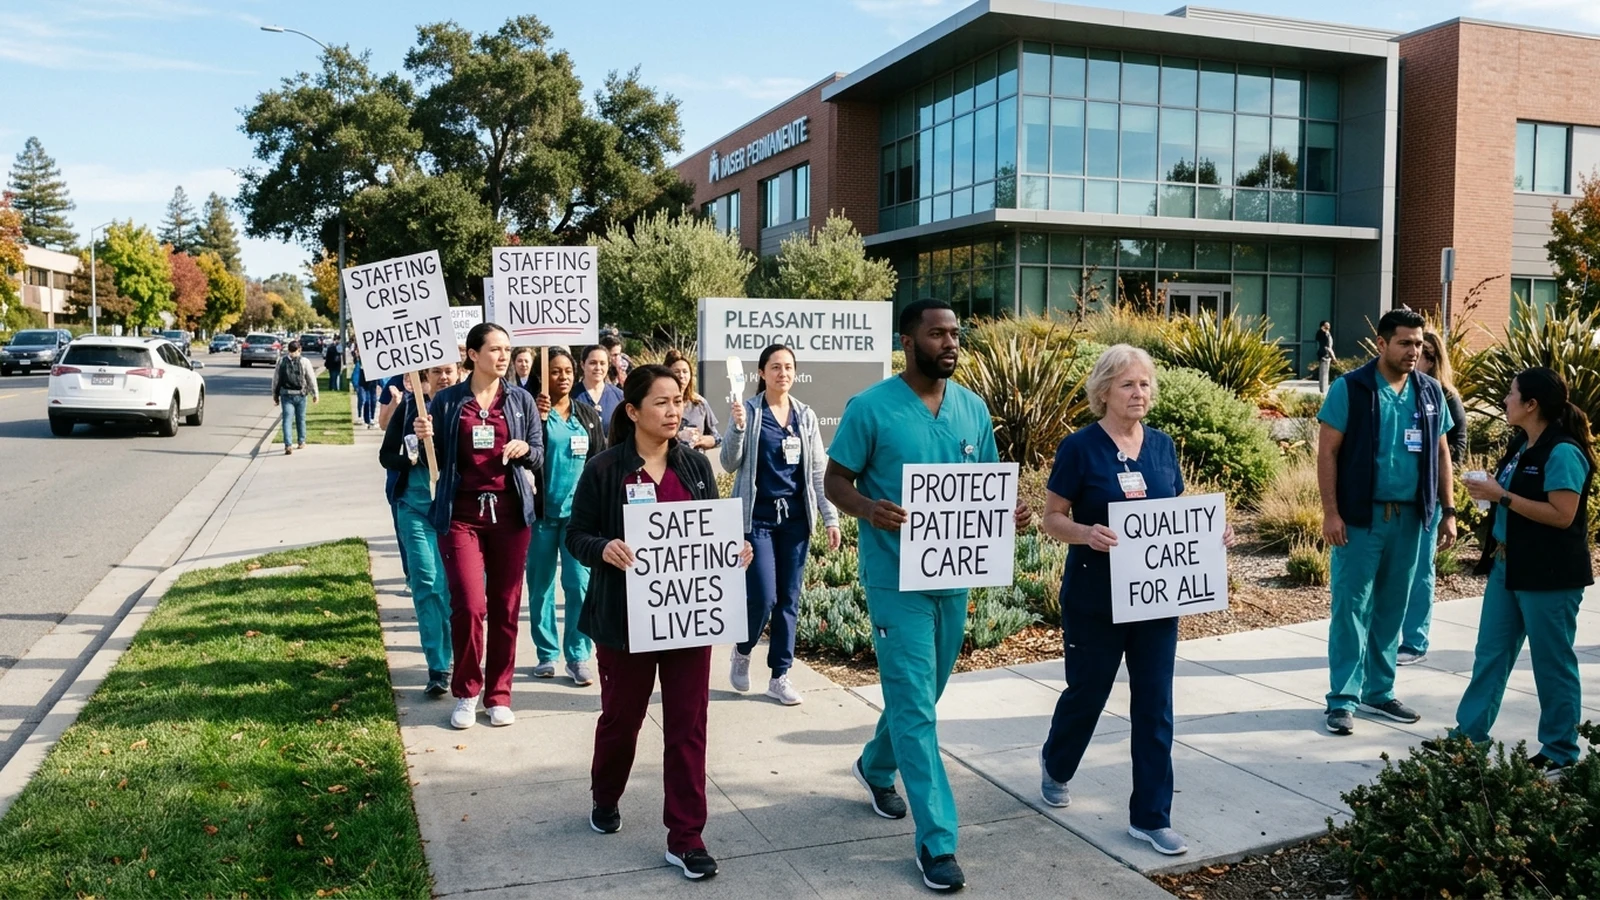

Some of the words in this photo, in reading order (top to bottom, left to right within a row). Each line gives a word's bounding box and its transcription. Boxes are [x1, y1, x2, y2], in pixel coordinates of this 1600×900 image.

[350, 256, 437, 290] STAFFING
[499, 251, 592, 273] STAFFING
[366, 280, 430, 310] CRISIS
[507, 275, 587, 295] RESPECT
[508, 298, 591, 325] NURSES
[725, 310, 826, 329] PLEASANT
[831, 313, 872, 331] HILL
[362, 316, 442, 350] PATIENT
[725, 333, 805, 350] MEDICAL
[810, 335, 874, 351] CENTER
[376, 340, 444, 371] CRISIS
[910, 472, 1011, 503] PROTECT
[647, 508, 714, 540] SAFE
[910, 509, 1009, 541] PATIENT
[1123, 505, 1216, 539] QUALITY
[634, 540, 738, 576] STAFFING
[920, 545, 989, 577] CARE
[1144, 540, 1200, 570] CARE
[647, 575, 723, 608] SAVES
[1129, 578, 1168, 606] FOR
[1177, 573, 1215, 601] ALL
[651, 607, 725, 641] LIVES
